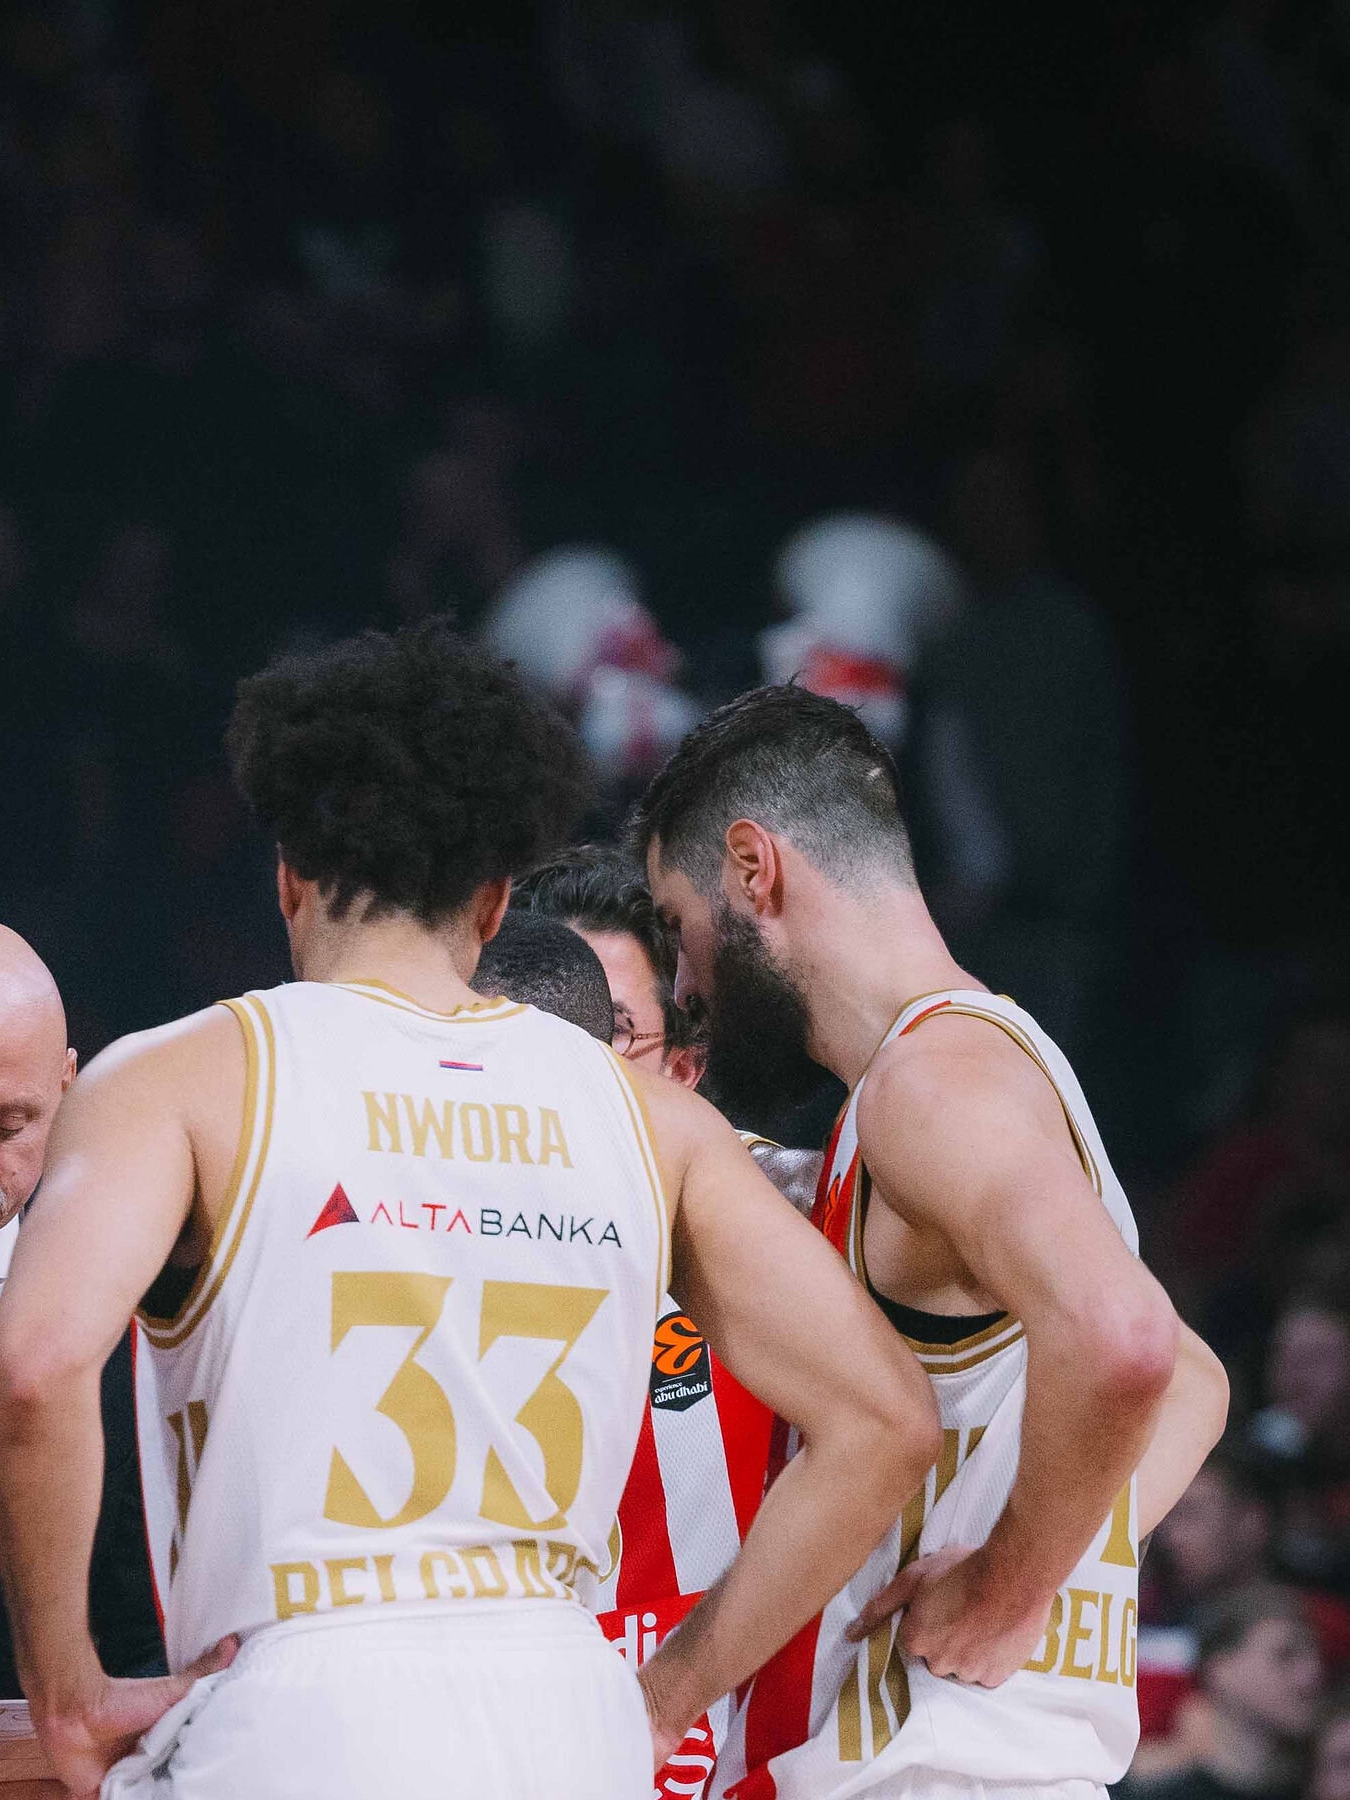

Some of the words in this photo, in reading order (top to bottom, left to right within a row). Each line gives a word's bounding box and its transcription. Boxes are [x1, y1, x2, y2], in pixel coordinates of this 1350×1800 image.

[362, 1090, 574, 1169] NWORA
[322, 1270, 610, 1530] 33
[654, 1391, 675, 1404] abu
[676, 1381, 708, 1398] dhabi
[1020, 1587, 1136, 1689] BELG
